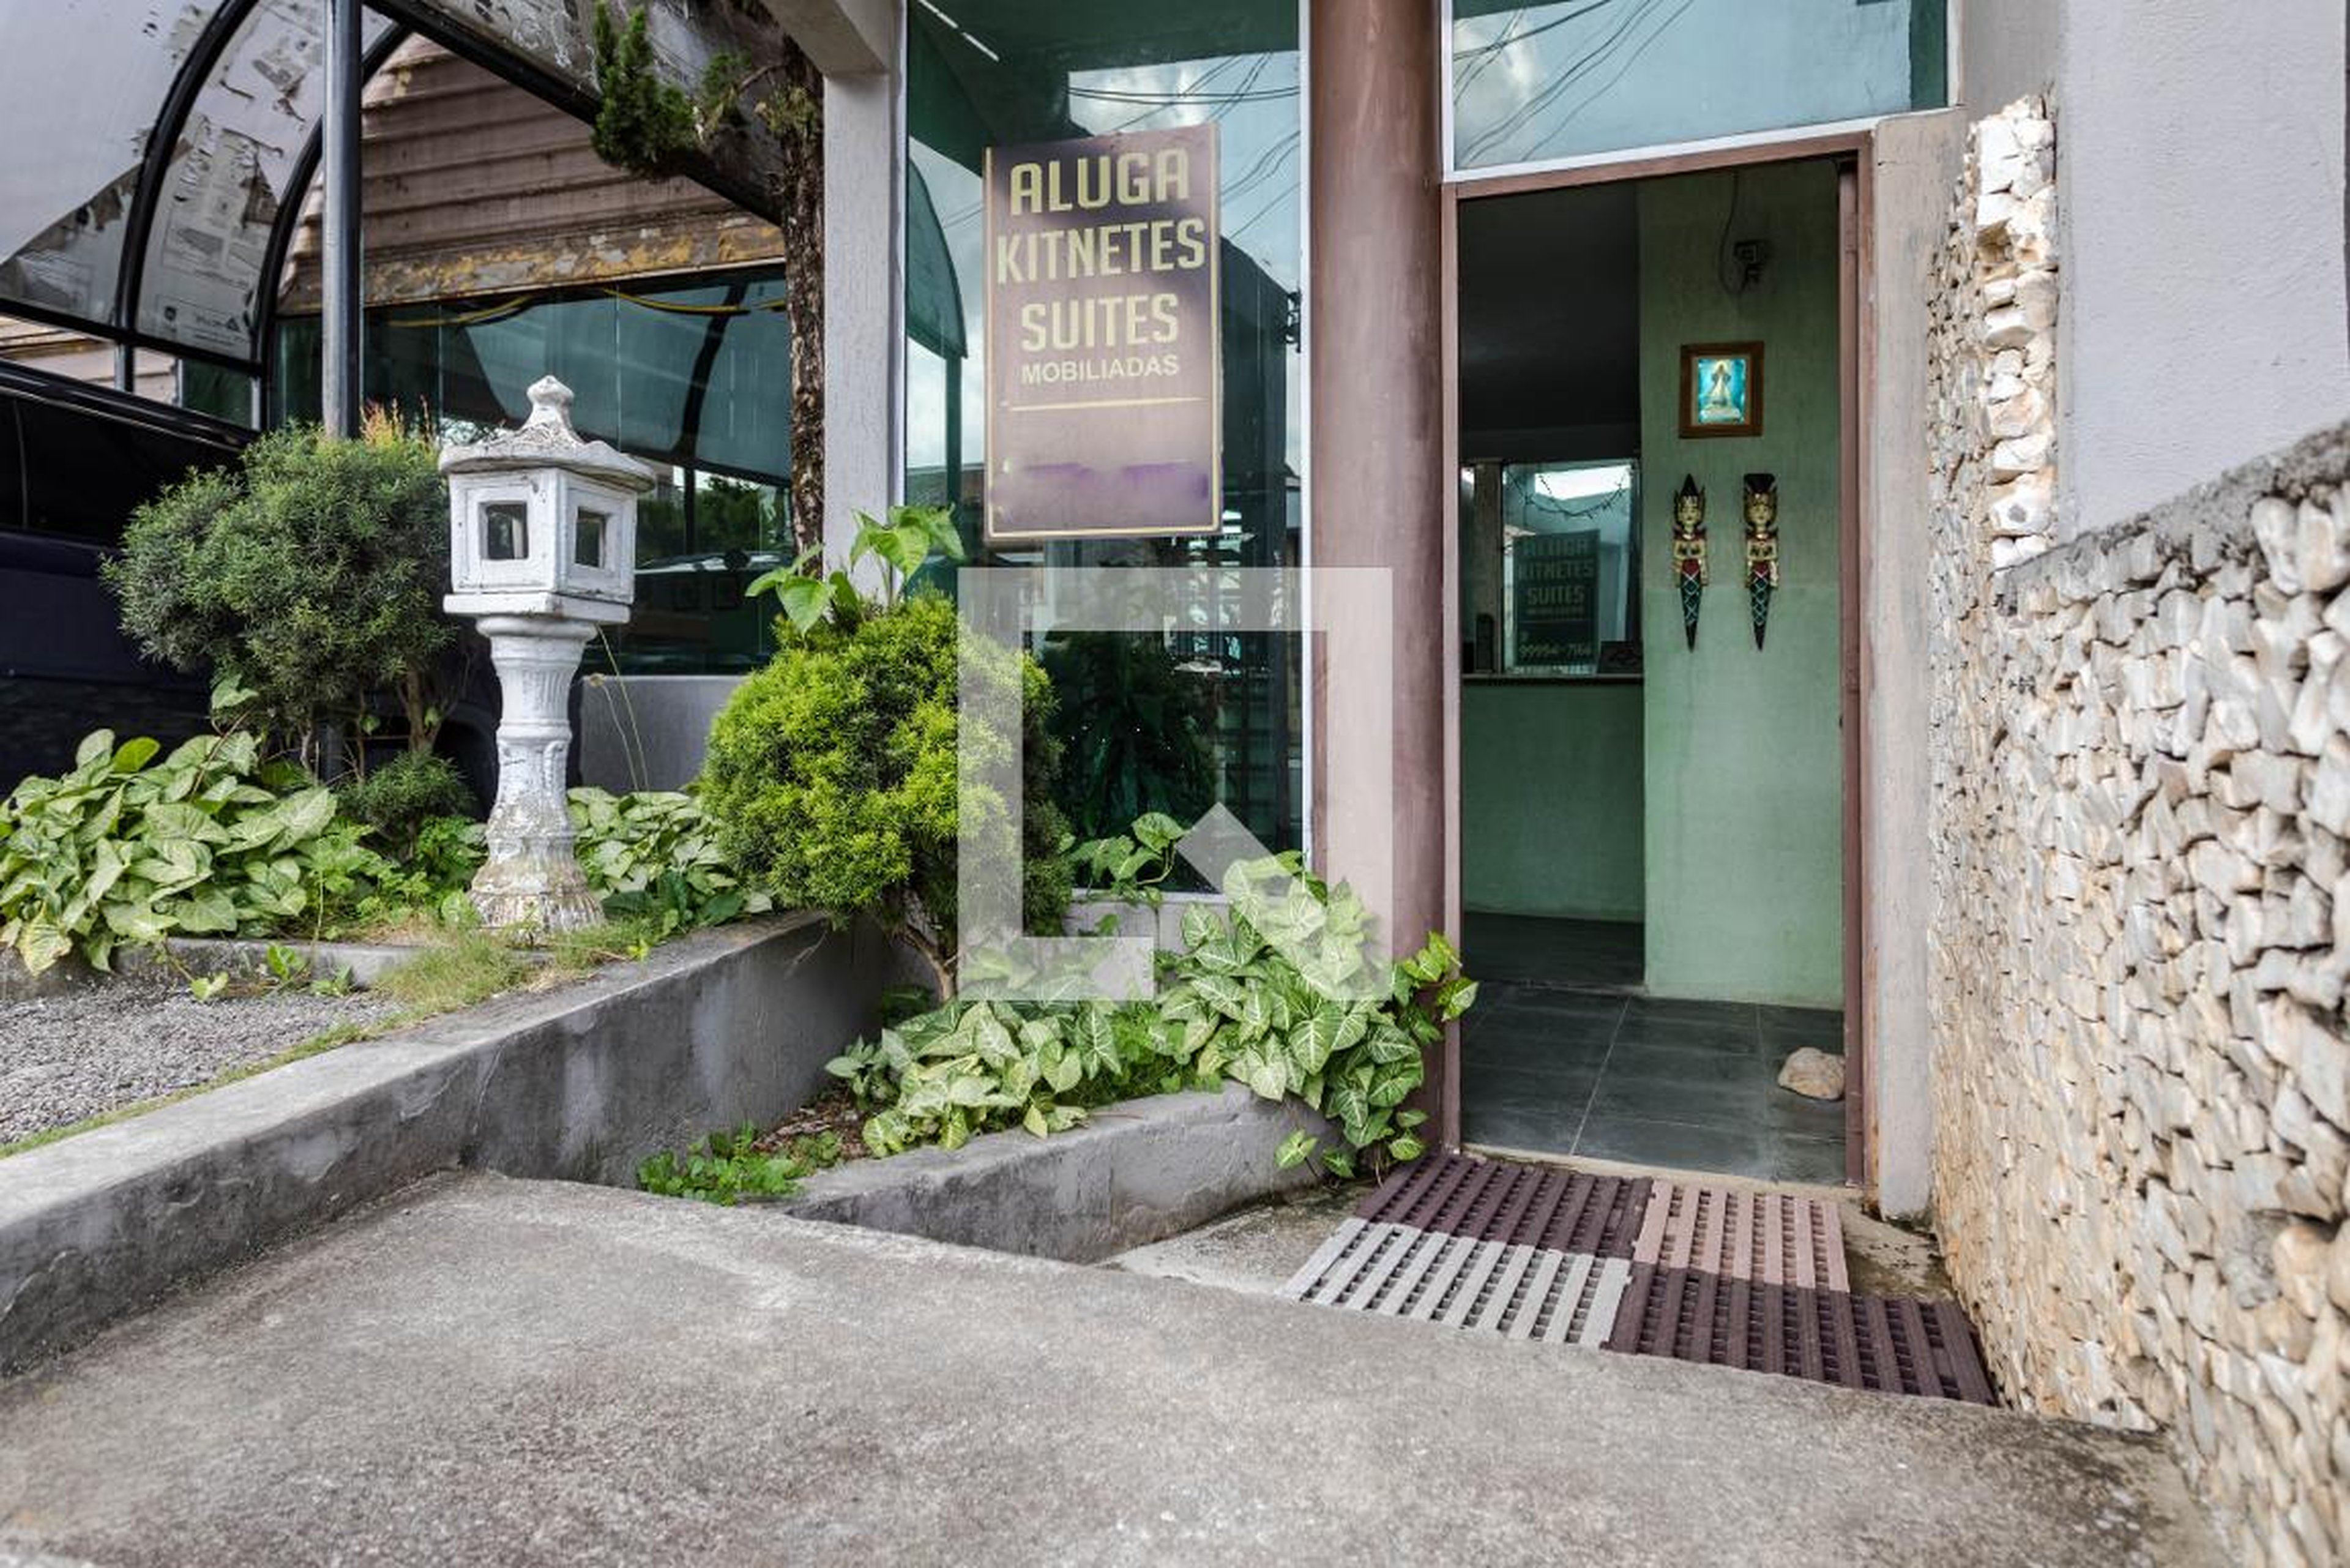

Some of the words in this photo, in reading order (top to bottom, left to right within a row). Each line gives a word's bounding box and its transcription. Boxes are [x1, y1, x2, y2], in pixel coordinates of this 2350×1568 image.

[1009, 148, 1190, 216] ALUGA
[996, 218, 1206, 284] KITNETES
[1020, 293, 1179, 352] SUITES
[1021, 354, 1180, 385] MOBILIADAS
[1527, 585, 1585, 605] SUITES
